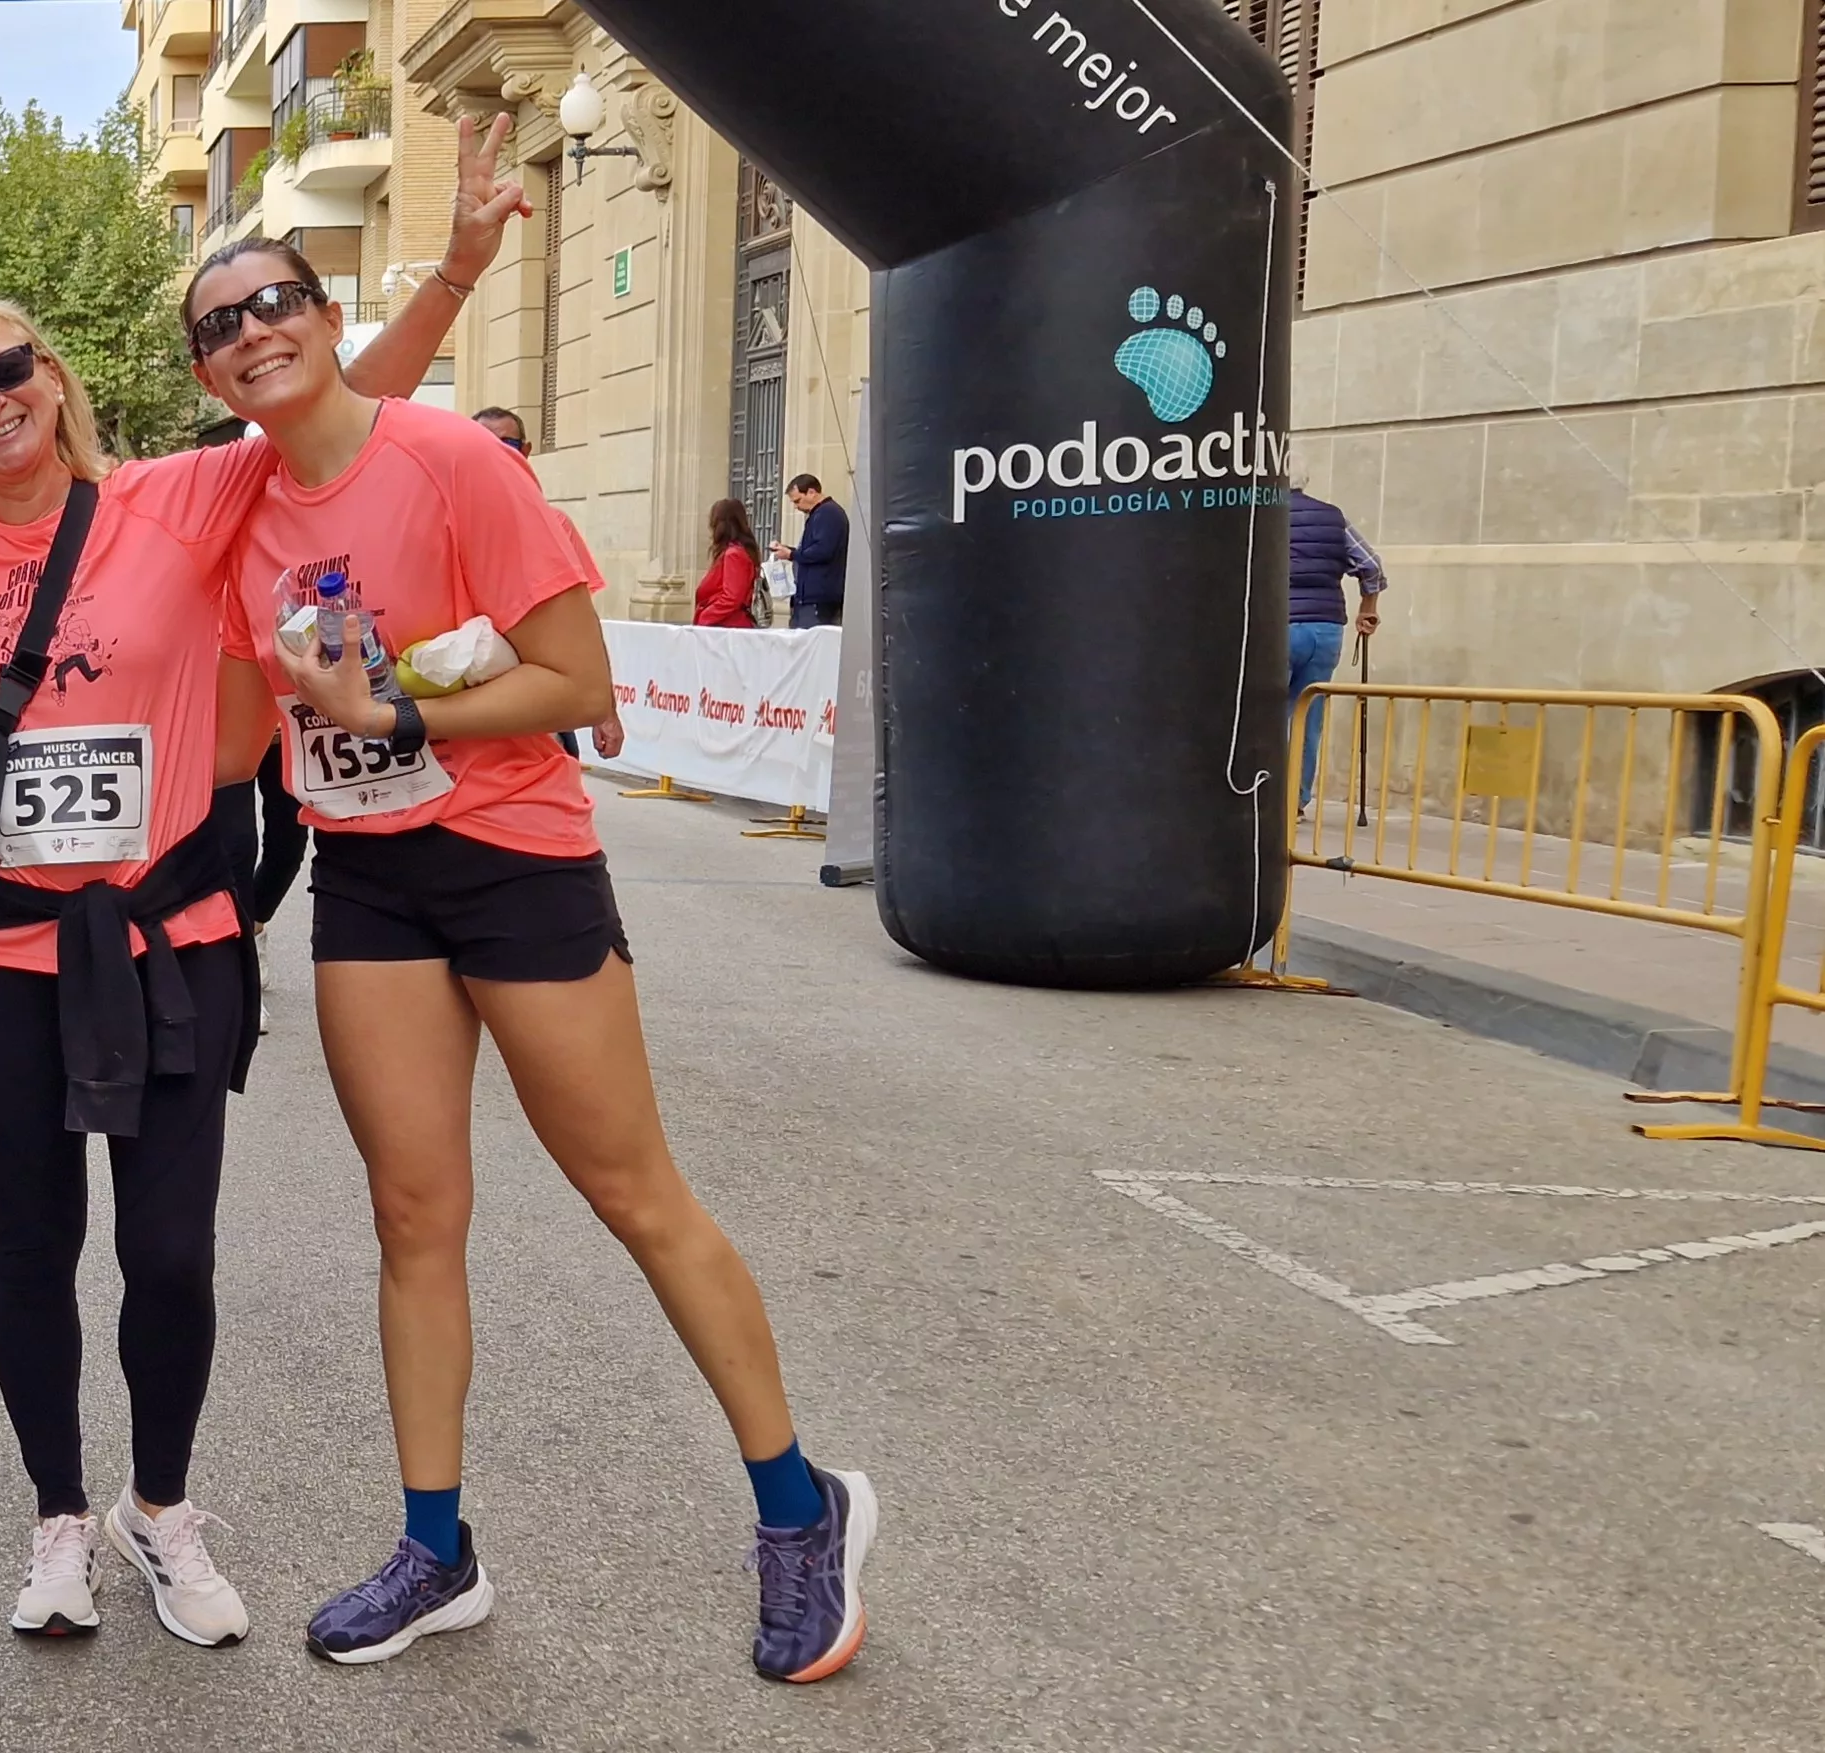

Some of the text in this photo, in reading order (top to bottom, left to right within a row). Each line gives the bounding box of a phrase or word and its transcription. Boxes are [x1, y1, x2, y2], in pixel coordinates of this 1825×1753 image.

[1031, 10, 1178, 135] mejor
[1012, 487, 1171, 519] PODOLOGÍA
[1179, 489, 1194, 510] Y
[6, 559, 44, 591] CORRA
[643, 679, 691, 719] Alcampo
[696, 686, 746, 729] Alcampo
[5, 749, 136, 773] ONTRA EL CÁNCER
[42, 742, 88, 755] HUESCA
[14, 772, 122, 828] 525
